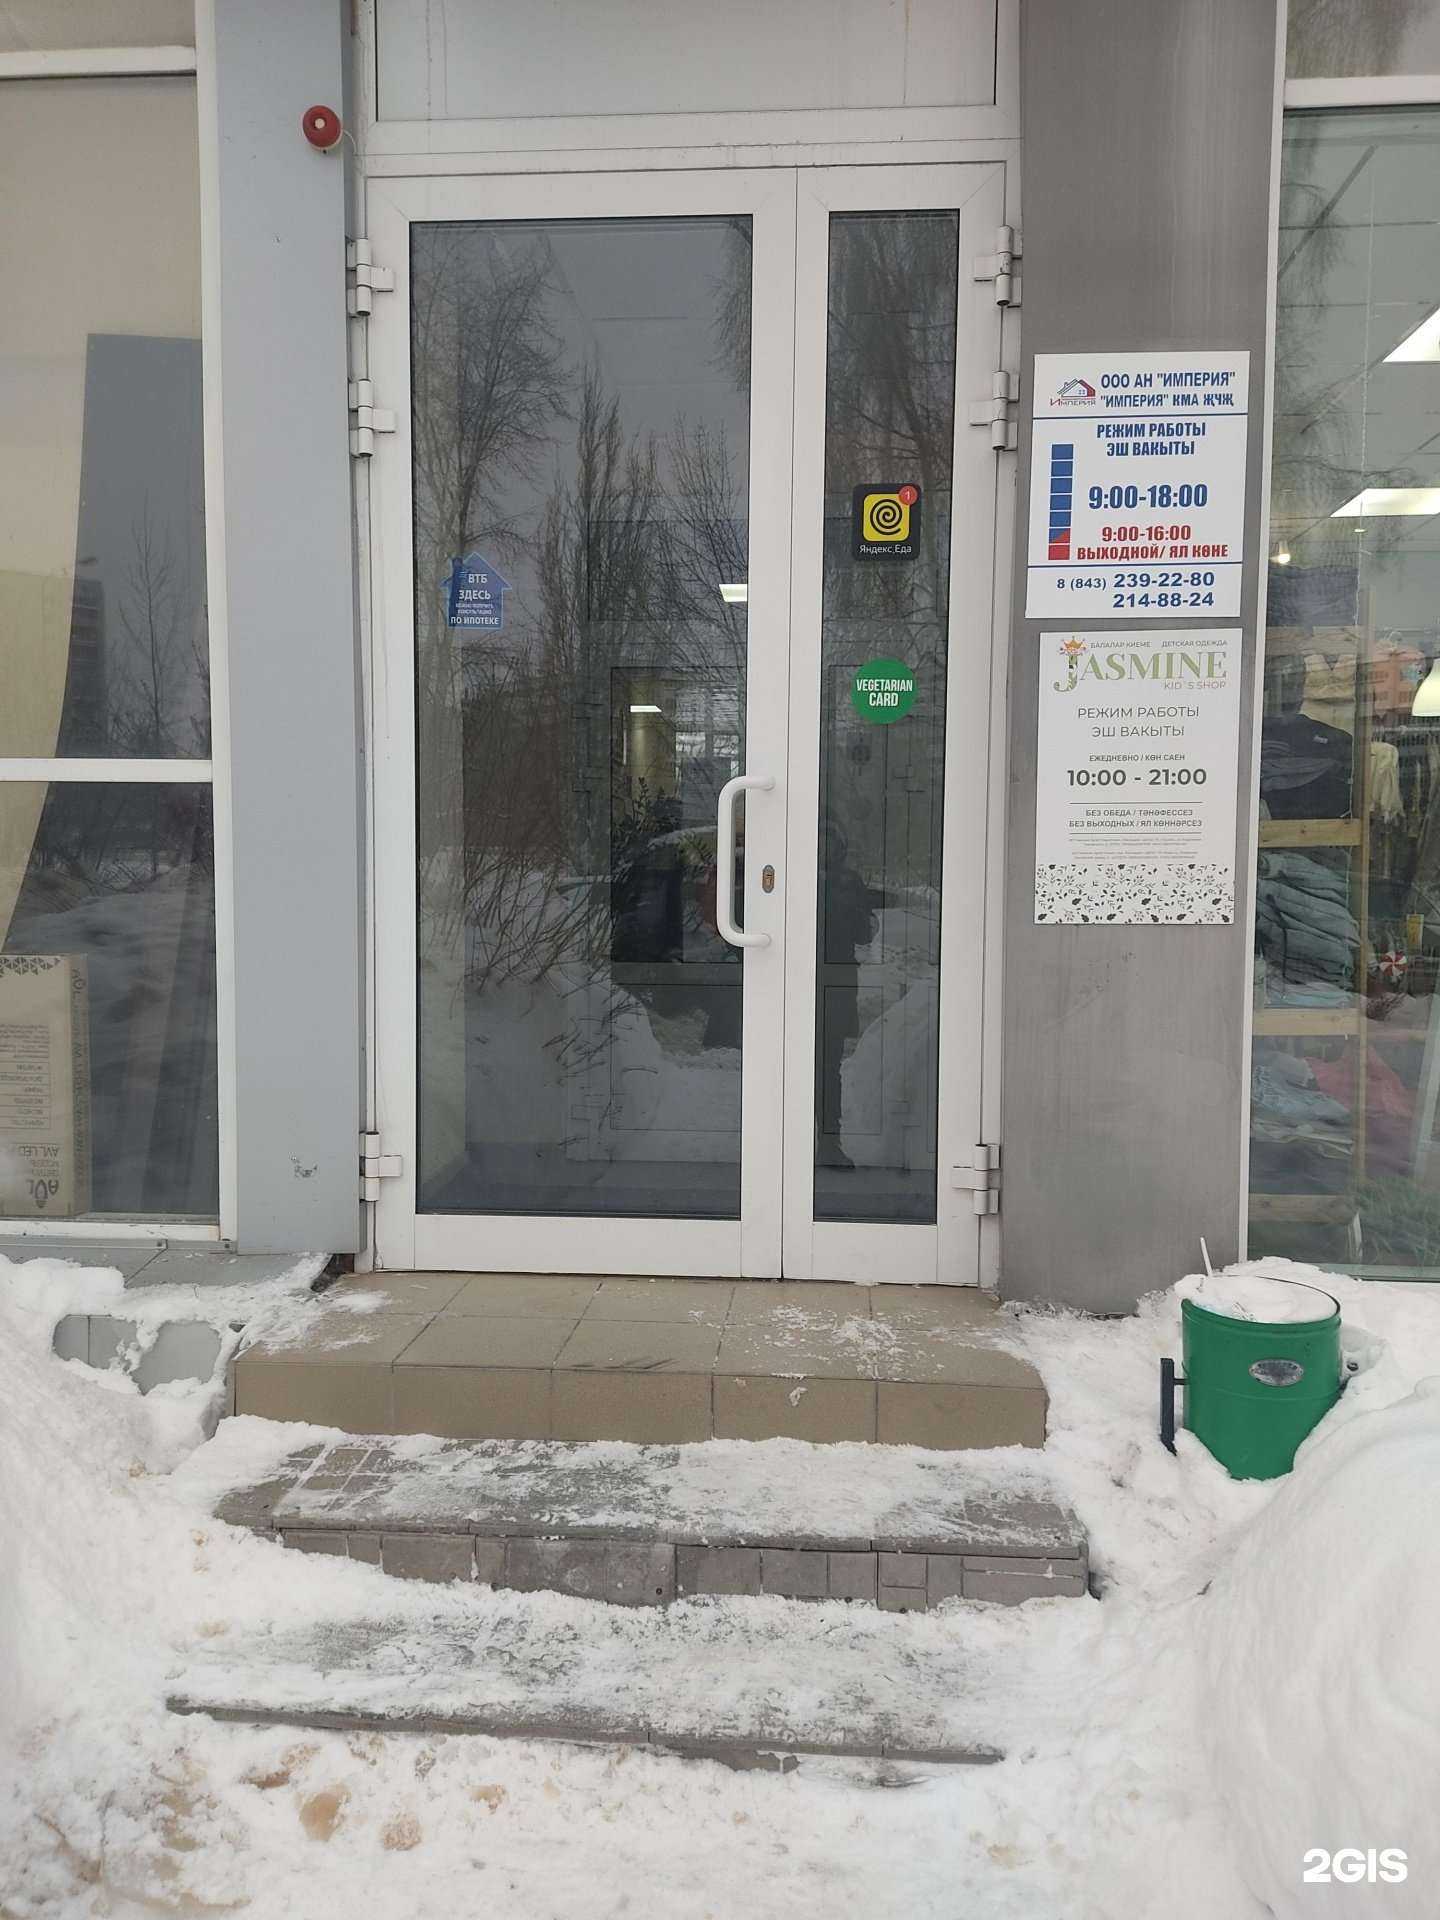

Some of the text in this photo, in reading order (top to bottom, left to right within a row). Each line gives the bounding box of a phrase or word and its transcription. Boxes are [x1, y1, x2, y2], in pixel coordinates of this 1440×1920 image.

[1101, 372, 1235, 388] ООО АН "ИМПЕРИЯ"
[1100, 394, 1169, 408] "ИМПЕРИЯ"
[1172, 393, 1199, 407] КМА
[1097, 422, 1206, 439] РЕЖИМ РАБОТЫ
[1106, 441, 1195, 456] ЭШ ВАКЫТЫ
[1088, 484, 1208, 509] 9:00-18:00
[1101, 525, 1192, 542] 9:00-16:00
[1169, 546, 1189, 559] ЯЛ
[1192, 544, 1229, 559] КӨНЕ
[468, 573, 488, 584] ВТБ
[1056, 572, 1215, 591] 8 (843) 239-22-80
[458, 589, 492, 602] ЗДЕСЬ
[1112, 592, 1214, 608] 214-88-24
[450, 616, 500, 625] ПО ИПОТЕКЕ
[1161, 640, 1194, 648] ДЕТСКАЯ
[1053, 651, 1227, 692] JASMINE
[856, 679, 913, 692] VEGETARIAN
[1195, 681, 1227, 690] SHOP
[869, 692, 899, 707] CARD
[1078, 706, 1200, 719] РЕЖИМ РАБОТЫ
[1092, 726, 1185, 738] ЭШ ВАКЫТЫ
[1089, 755, 1139, 763] ЕЖЕДНЕВНО
[1067, 769, 1127, 787] 10:00
[1149, 768, 1207, 786] 21:00
[1086, 809, 1101, 817] БЕЗ
[1103, 809, 1131, 817] ОБЕДА
[1069, 820, 1085, 828] БЕЗ
[1086, 820, 1135, 828] ВЫХОДНЫХ
